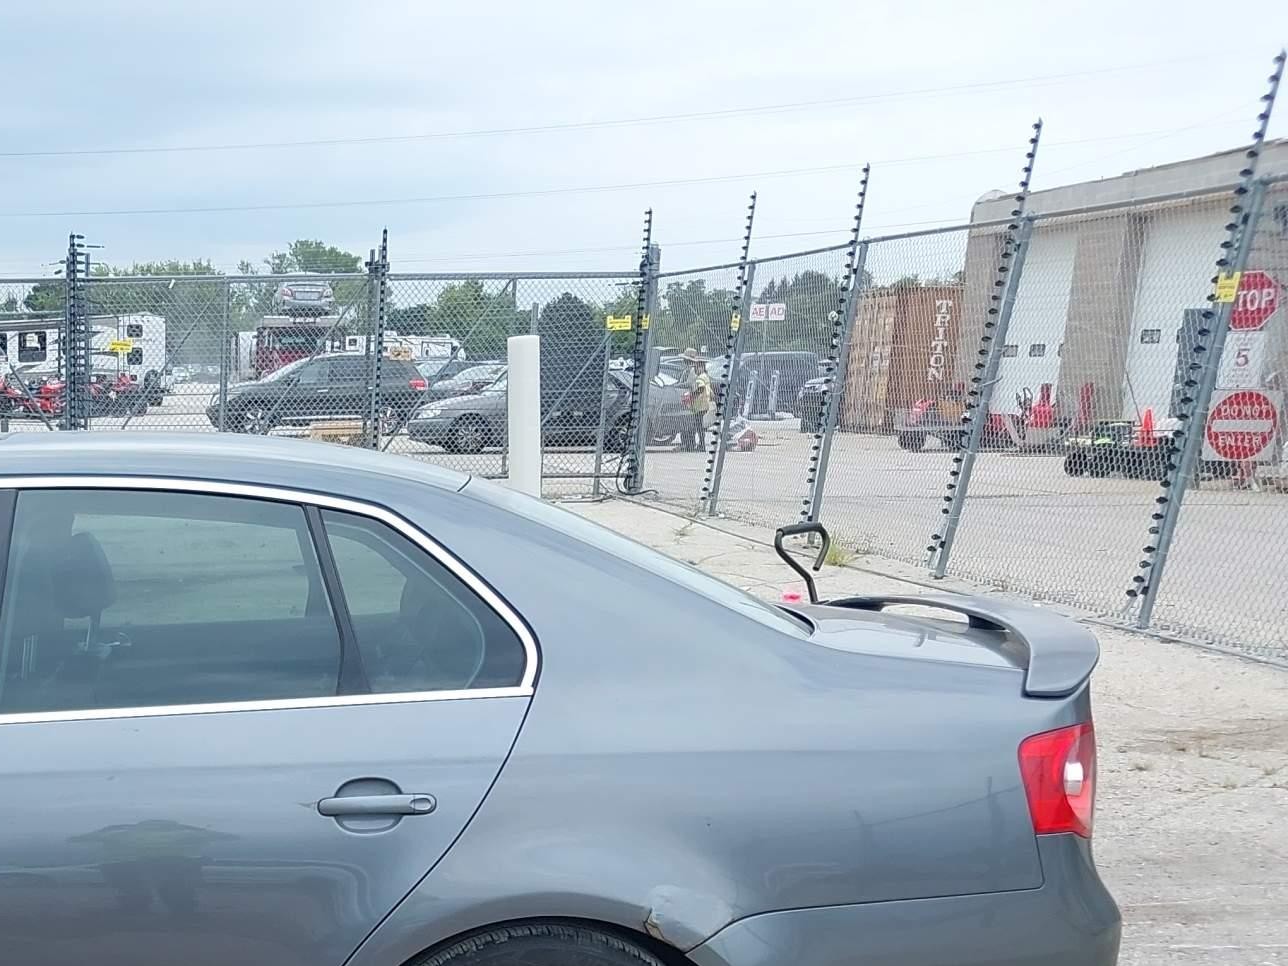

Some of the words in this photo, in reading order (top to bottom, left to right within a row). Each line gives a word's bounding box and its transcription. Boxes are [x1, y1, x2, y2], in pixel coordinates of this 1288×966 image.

[1237, 288, 1275, 311] TOP
[752, 307, 765, 317] AE
[770, 307, 784, 316] AD
[927, 300, 952, 381] TRITON
[1236, 348, 1249, 368] 5
[1222, 405, 1239, 416] DO
[1243, 404, 1270, 416] NOT
[1219, 435, 1261, 447] ENTER
